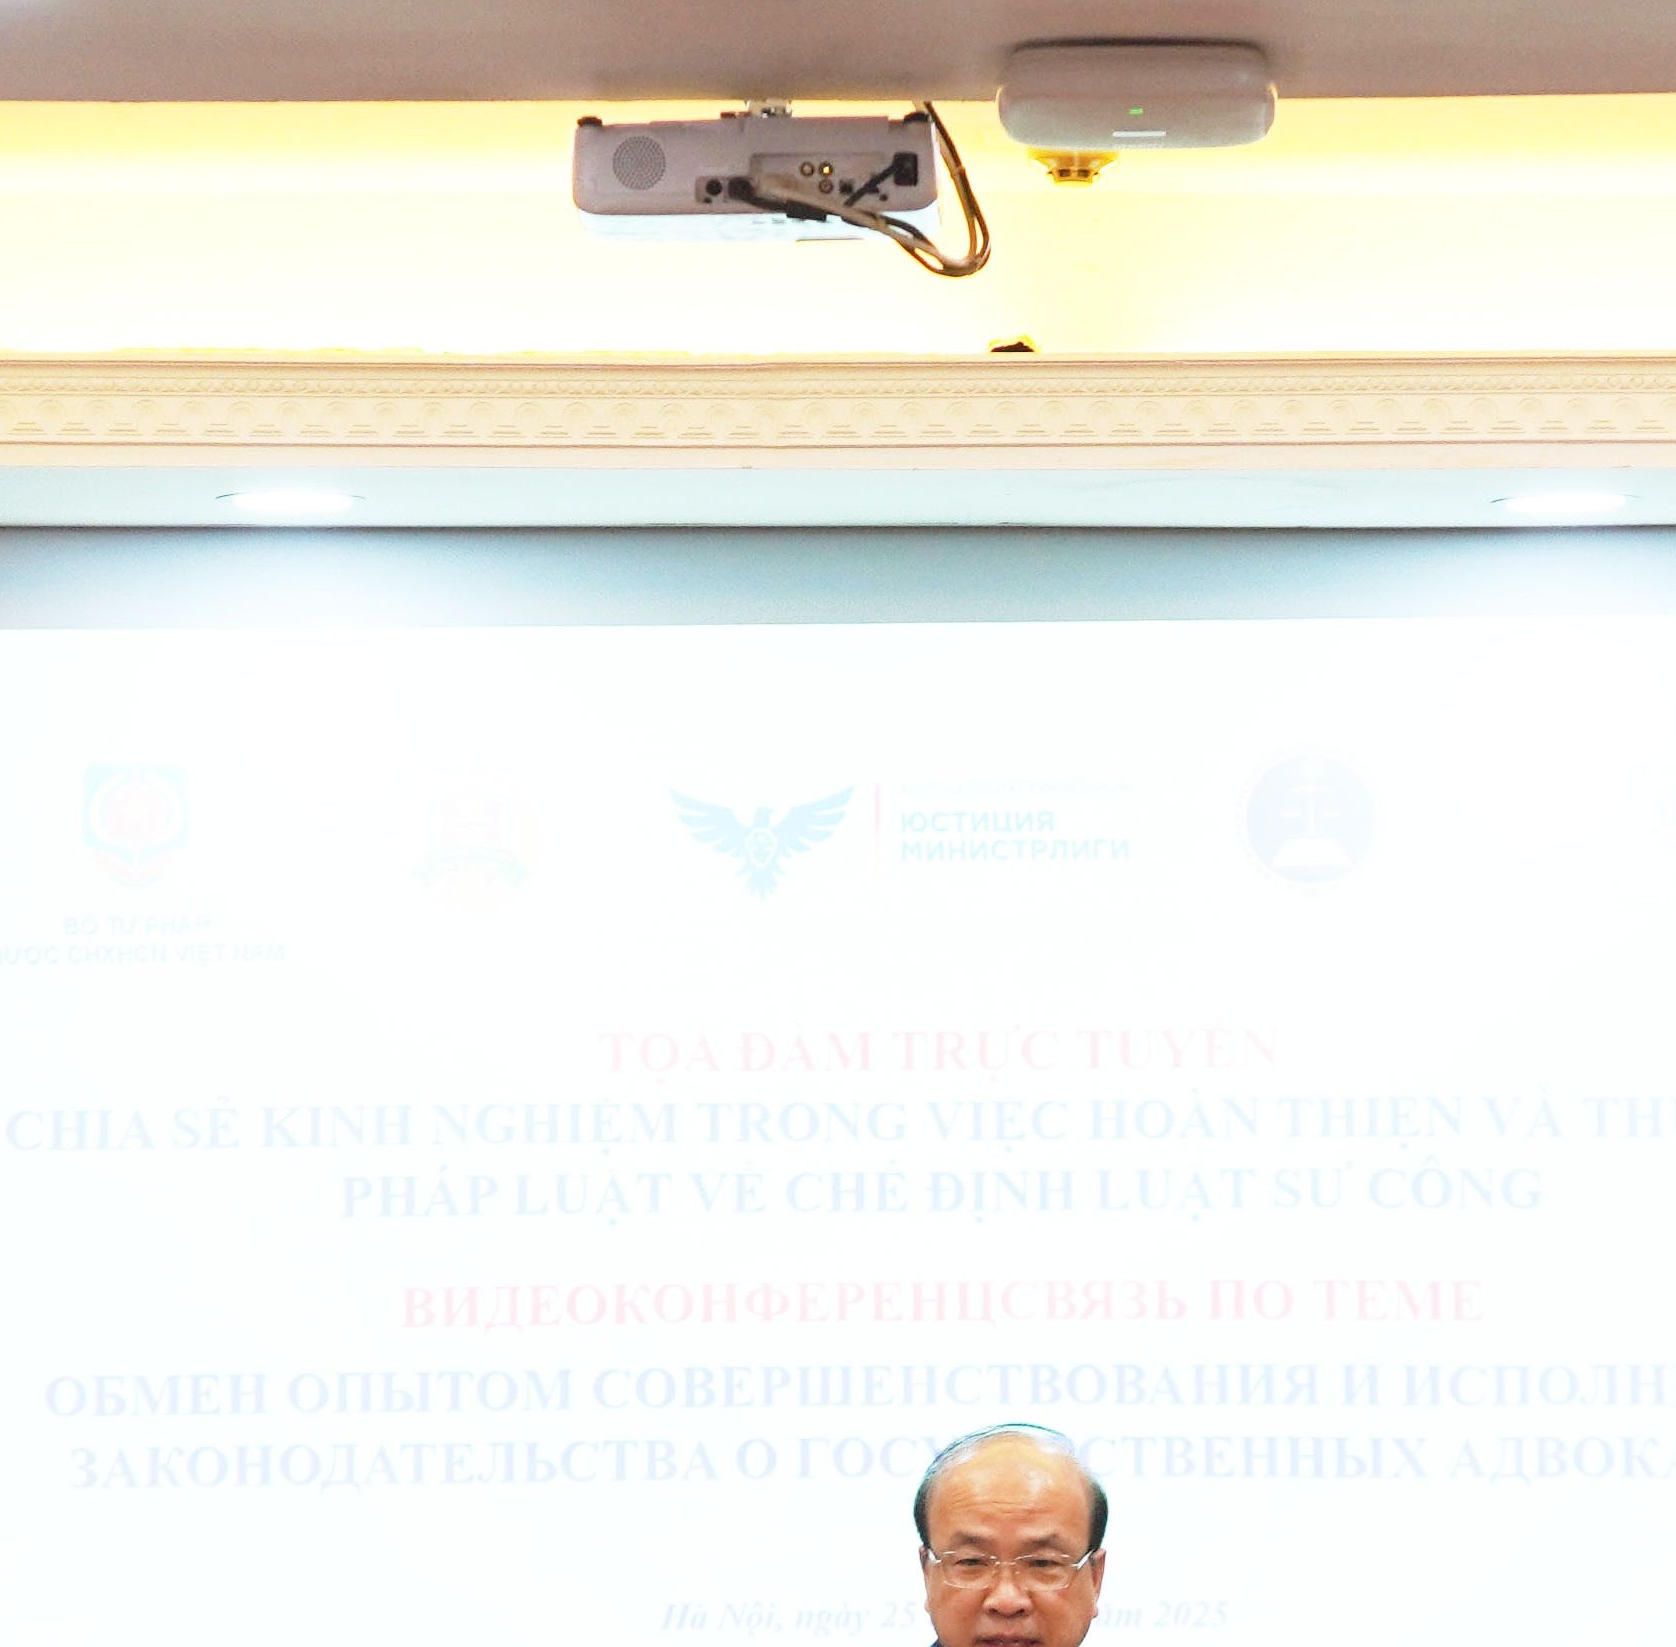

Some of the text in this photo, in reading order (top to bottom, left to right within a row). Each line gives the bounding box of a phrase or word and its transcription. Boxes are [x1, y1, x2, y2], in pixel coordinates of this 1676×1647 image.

[900, 808, 1056, 834] ЮСТИЦИЯ
[900, 837, 1132, 861] МИНИСТРЛИГИ
[598, 1029, 721, 1085] TỌA
[737, 1016, 873, 1073] ĐÀM
[891, 1024, 1061, 1083] TRỰC
[4, 1108, 156, 1151] CHIA
[172, 1094, 240, 1150] SẺ
[259, 1102, 413, 1149] KINH
[431, 1097, 678, 1155] NGHIỆM
[698, 1100, 907, 1145] TRONG
[925, 1095, 1070, 1153] VIỆC
[1088, 1086, 1264, 1142] HOÀN
[1276, 1090, 1464, 1150] THIỆN
[1487, 1085, 1564, 1141] VÀ
[340, 1162, 501, 1218] PHÁP
[511, 1163, 674, 1227] LUẬT
[924, 1167, 1076, 1223] ĐỊNH
[1093, 1163, 1255, 1222] LUẬT
[1271, 1158, 1355, 1209] SƯ
[1367, 1153, 1543, 1210] CÔNG
[401, 1277, 1486, 1332] ВИДЕОКОНФЕРЕНЦСВЯЗЬ ПО ТЕМЕ
[44, 1372, 269, 1417] ОБМЕН
[286, 1368, 574, 1414] ОПЫТОМ
[591, 1362, 1320, 1412] СОВЕРШЕНСТВОВАНИЯ
[1339, 1363, 1382, 1407] И
[68, 1437, 719, 1494] ЗАКОНОДАТЕЛЬСТВА
[733, 1438, 778, 1481] О
[795, 1433, 1429, 1482] ГОССТВЕННЫХ
[660, 1600, 917, 1635] Hà Nội, ngày 25
[1096, 1599, 1230, 1629] ăm 2025
